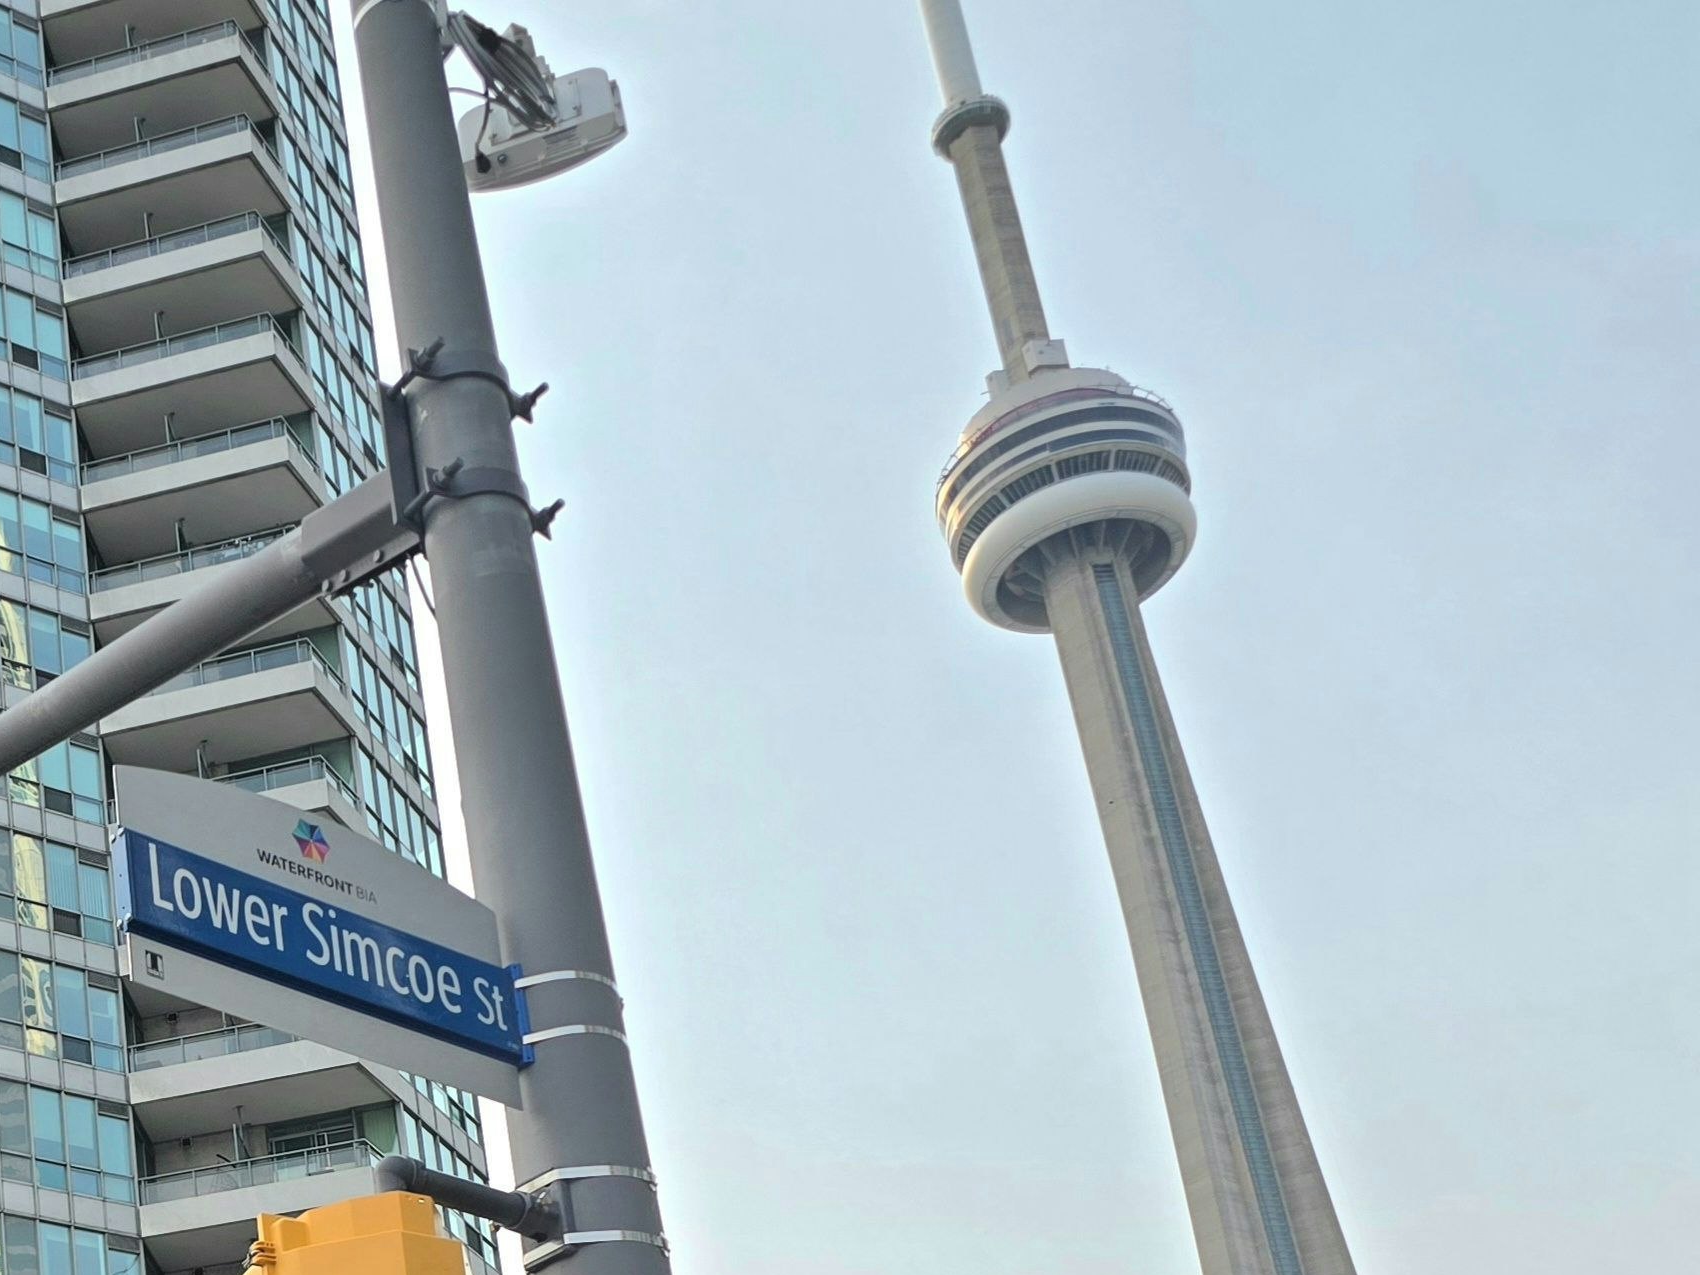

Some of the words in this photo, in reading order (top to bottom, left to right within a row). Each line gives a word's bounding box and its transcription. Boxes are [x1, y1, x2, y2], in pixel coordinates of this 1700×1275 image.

[147, 842, 289, 953] Lower
[301, 902, 462, 1014] Simcoe
[473, 976, 508, 1031] St
[256, 849, 353, 895] WATERFRONT
[355, 885, 379, 905] BIA
